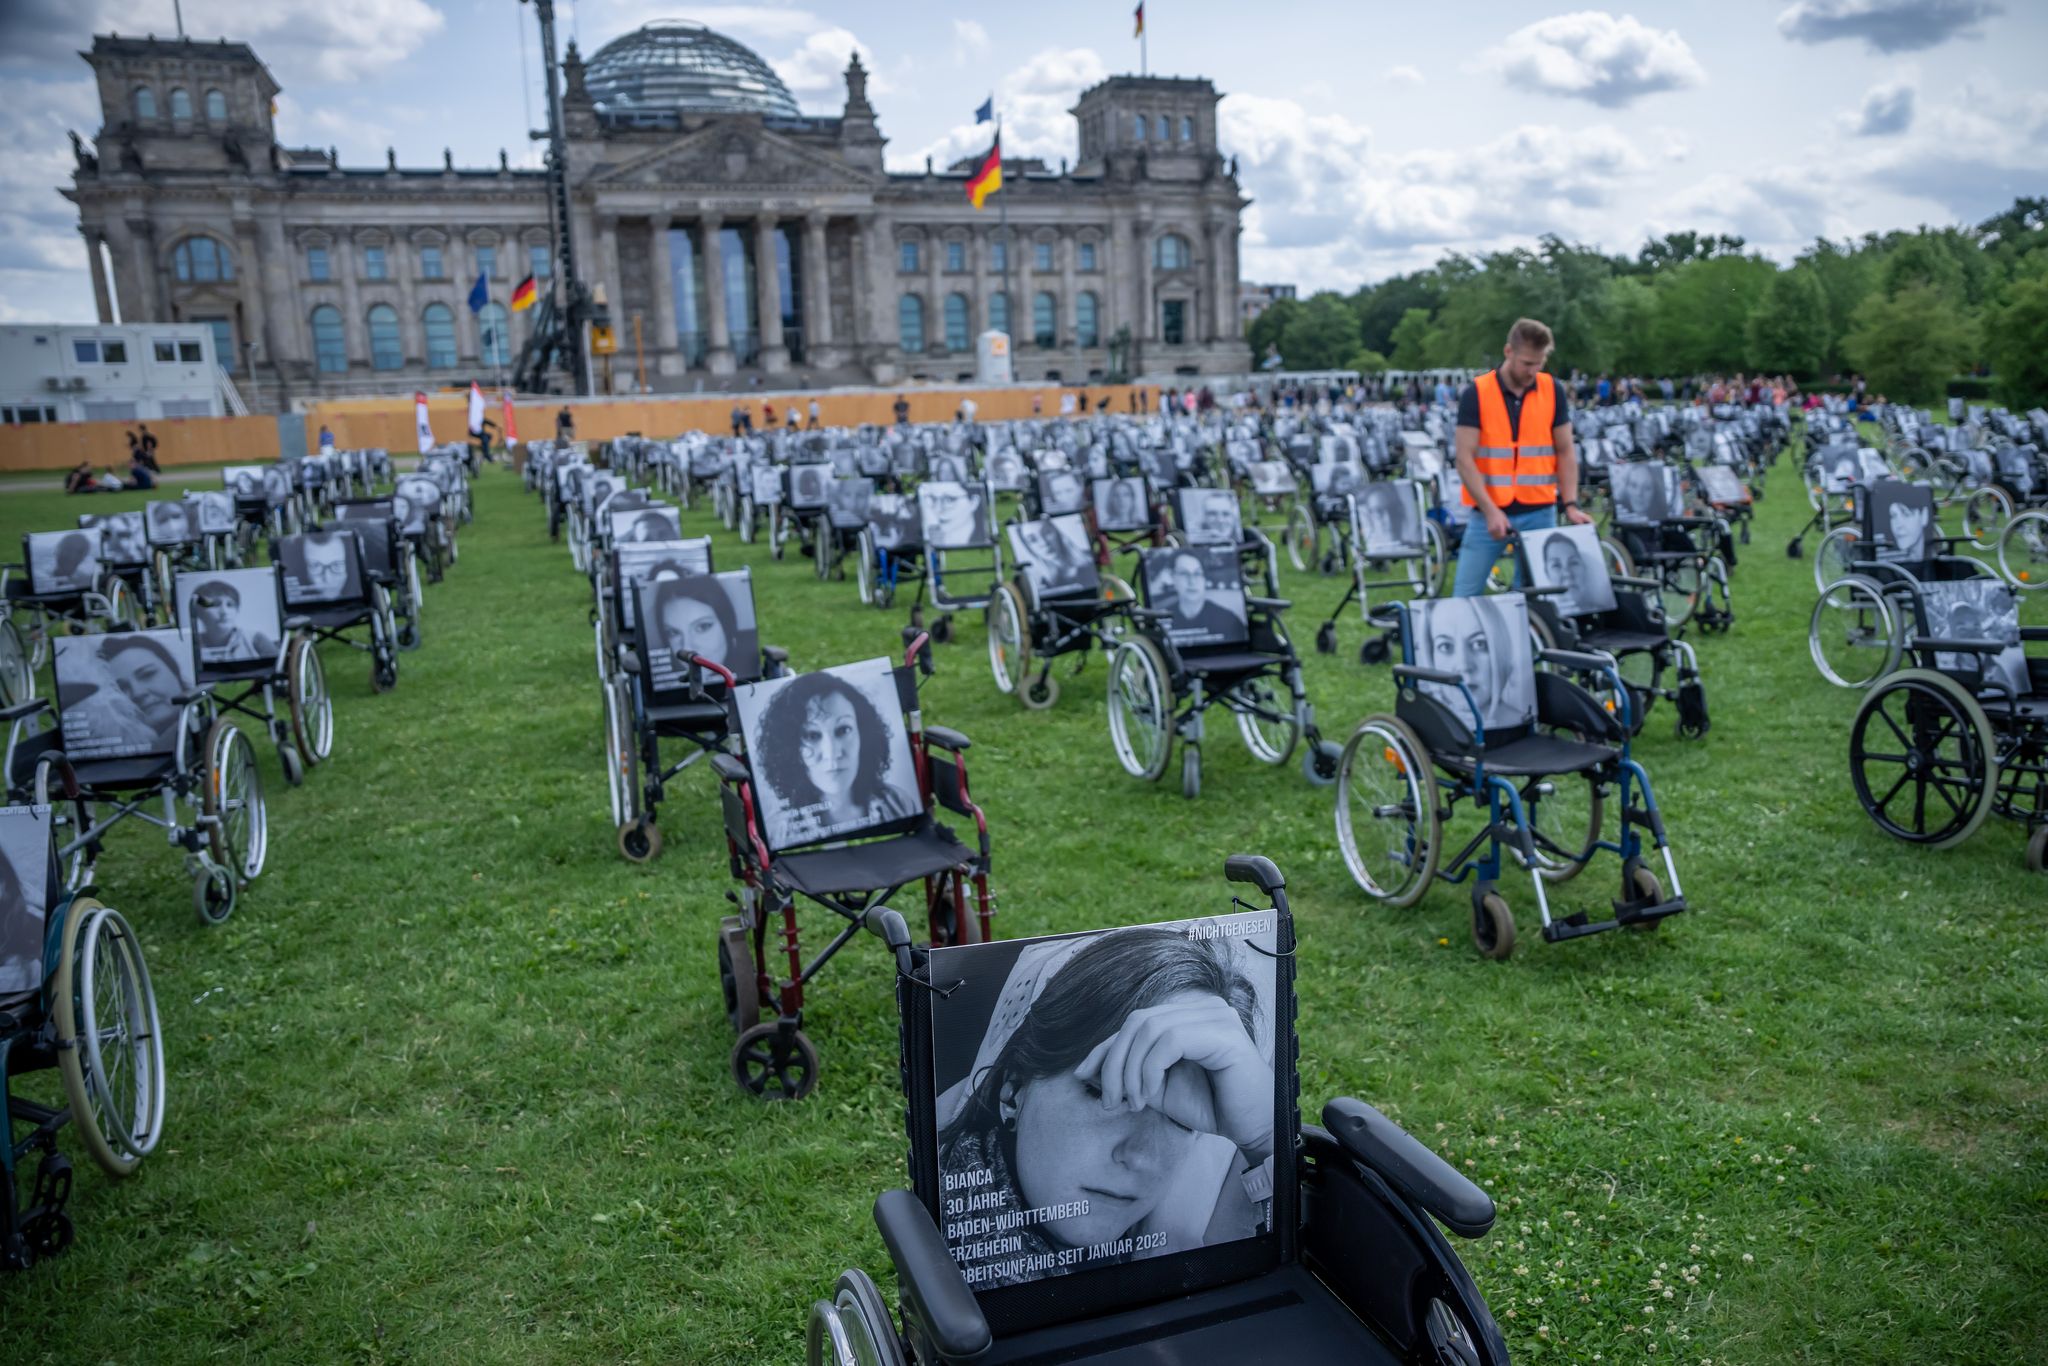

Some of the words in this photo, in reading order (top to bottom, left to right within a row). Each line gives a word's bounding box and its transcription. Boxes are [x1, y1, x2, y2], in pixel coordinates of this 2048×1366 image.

[1188, 918, 1272, 941] #NICHTGENESEN
[946, 1169, 993, 1191] BIANCA
[946, 1198, 964, 1215] 30
[967, 1190, 1007, 1212] JAHRE
[948, 1200, 1090, 1239] BADEN-WÜRTTEMBERG
[949, 1236, 1022, 1262] ERZIEHERIN
[1057, 1248, 1084, 1266] SEIT
[1087, 1238, 1133, 1260] JANUAR
[1136, 1231, 1167, 1251] 2023
